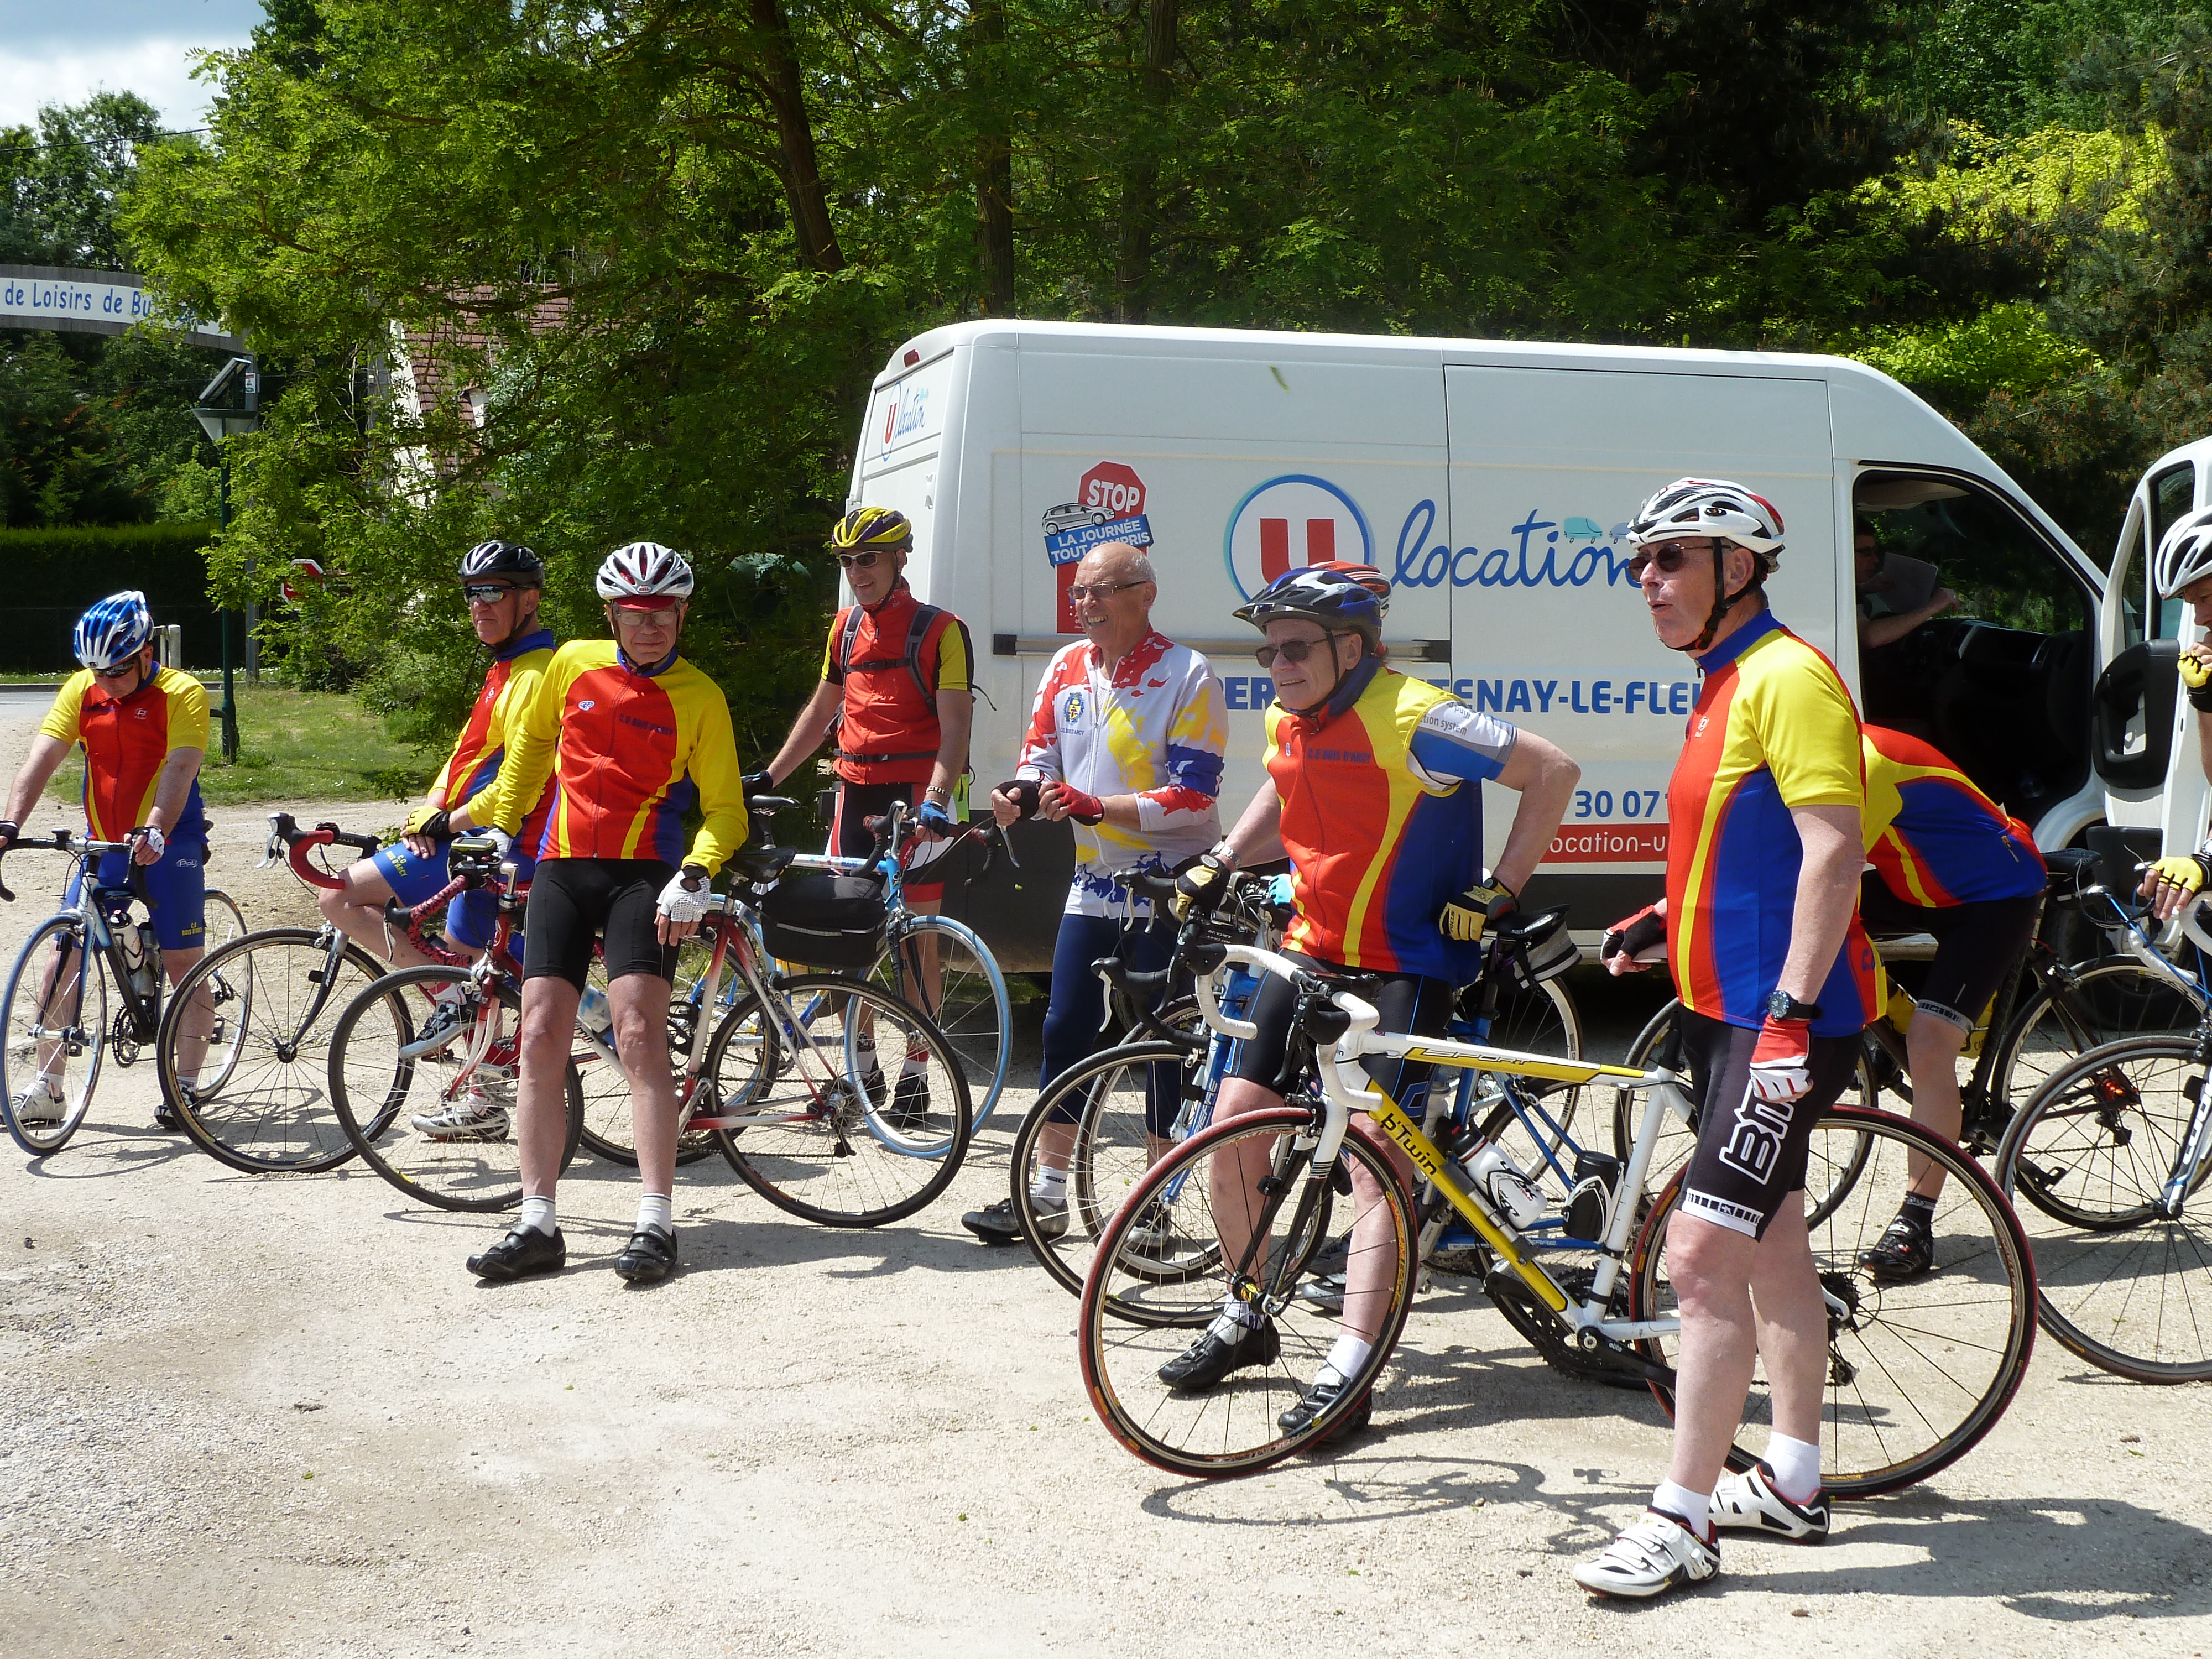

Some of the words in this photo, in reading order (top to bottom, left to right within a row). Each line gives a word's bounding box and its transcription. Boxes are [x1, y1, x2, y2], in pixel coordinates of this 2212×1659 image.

[6, 281, 25, 306] de
[33, 282, 92, 311] Loisirs
[103, 288, 123, 314] de
[885, 403, 897, 444] U
[1087, 479, 1140, 513] STOP
[1058, 534, 1077, 547] LA
[1079, 519, 1141, 542] JOURNÉE
[1260, 518, 1335, 586] U
[1390, 499, 1642, 588] location
[1051, 545, 1088, 562] TOUT
[1217, 677, 1277, 710] ER
[1440, 719, 1468, 736] system
[1575, 790, 1613, 818] 30
[1623, 790, 1660, 818] 07
[1423, 1050, 1532, 1065] SPORT
